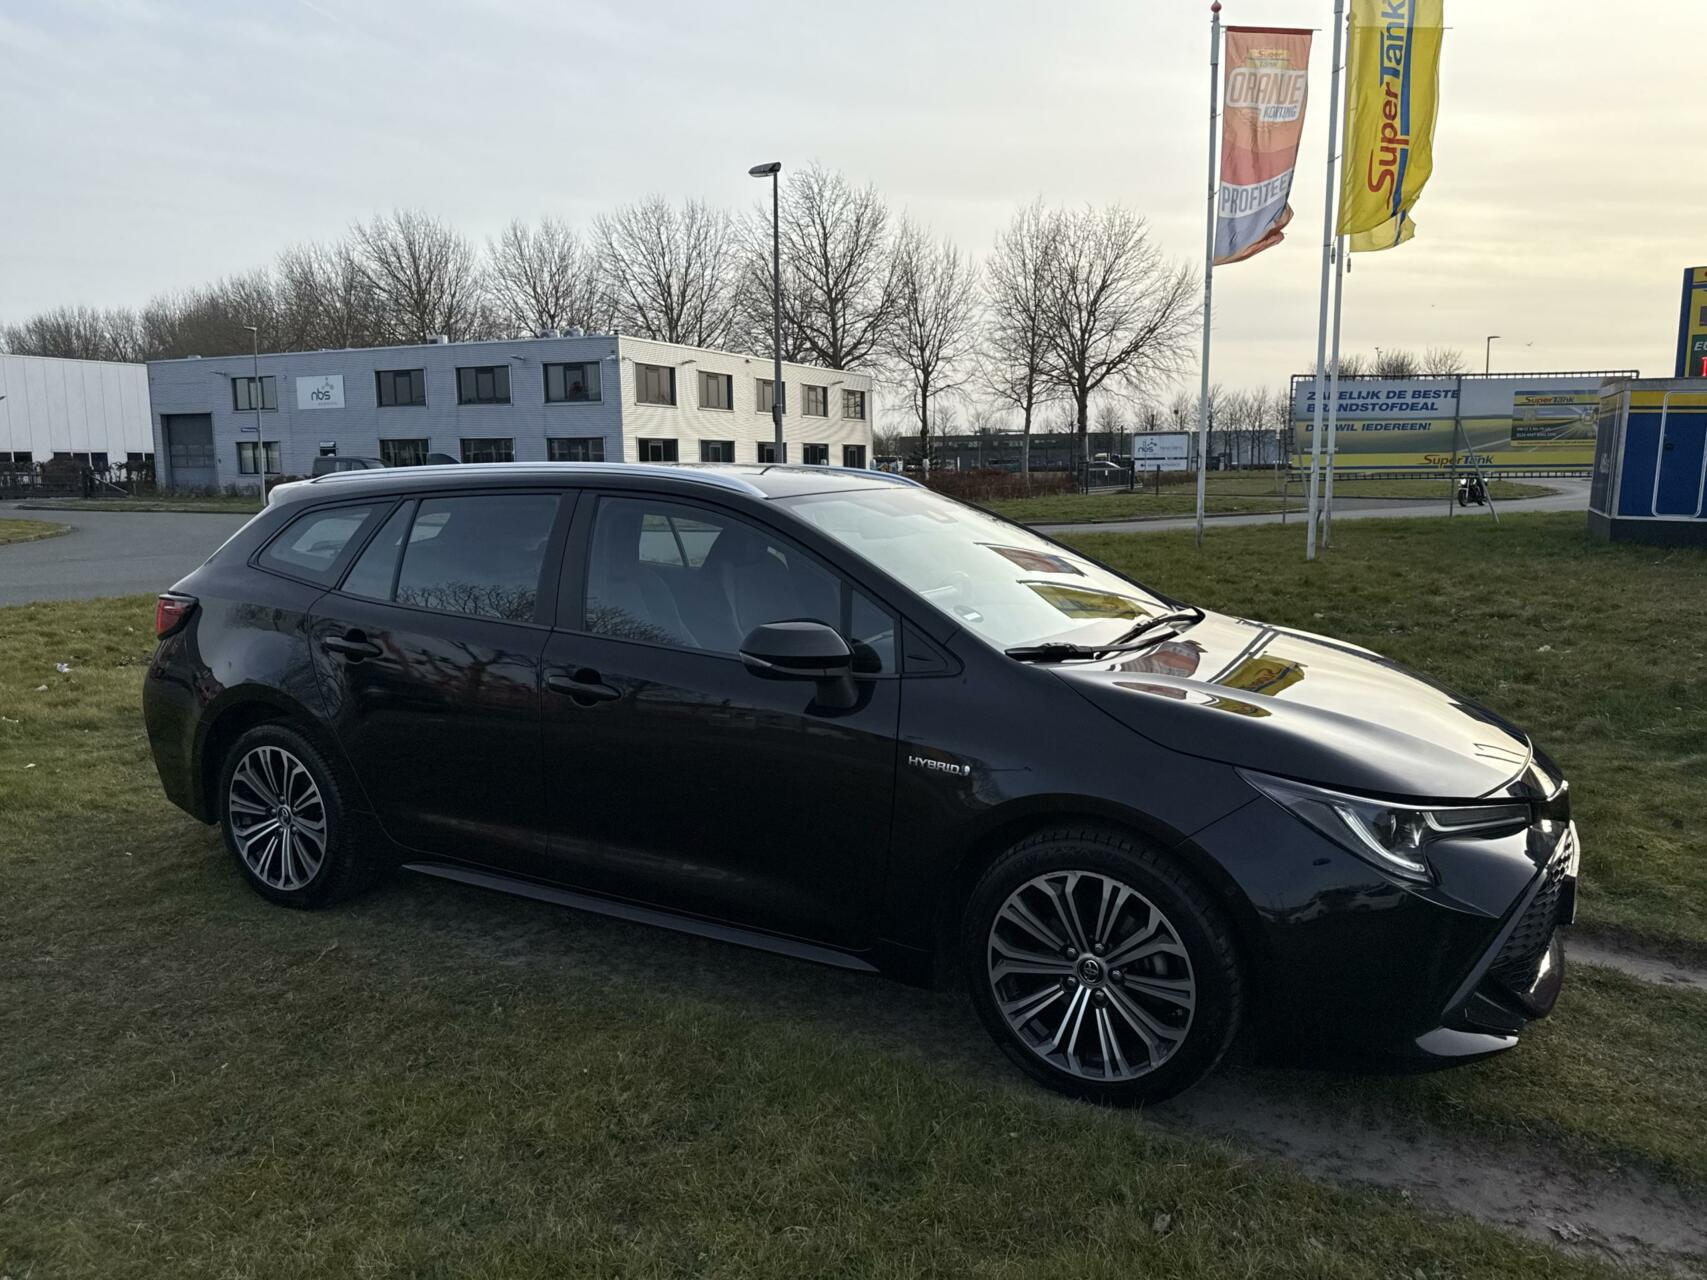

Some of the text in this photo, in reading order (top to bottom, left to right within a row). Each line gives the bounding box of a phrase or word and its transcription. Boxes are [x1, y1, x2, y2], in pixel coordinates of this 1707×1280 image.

[1229, 71, 1305, 105] ORANJE
[311, 388, 331, 401] nbs
[1306, 389, 1460, 401] ZELIJK DE BESTE
[1306, 402, 1439, 413] BRNDSTOFDEAL
[1305, 422, 1432, 432] DT WIL IEDEREEN!
[908, 755, 960, 775] HYBRID
